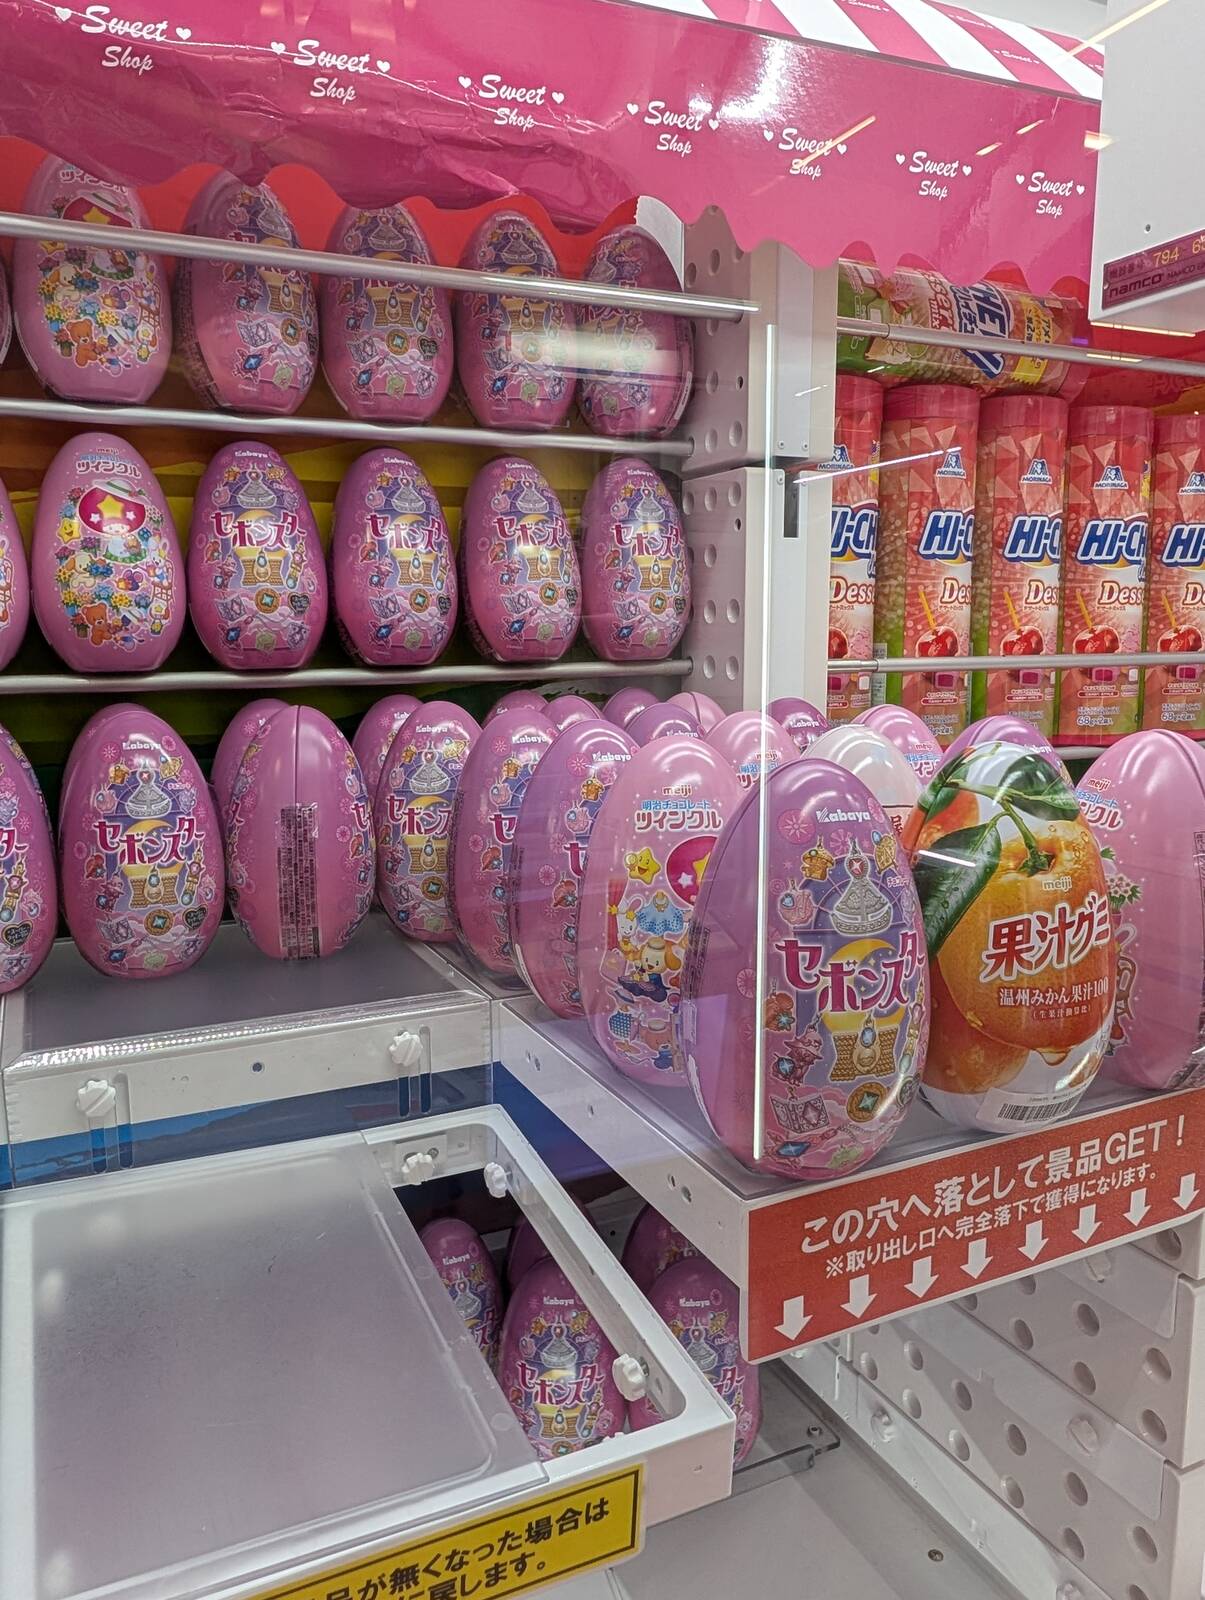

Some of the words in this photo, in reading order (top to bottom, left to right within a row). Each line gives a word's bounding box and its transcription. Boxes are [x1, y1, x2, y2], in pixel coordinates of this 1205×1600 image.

[81, 6, 168, 40] Sweet
[101, 46, 153, 75] Shop
[293, 40, 370, 73] Sweet
[310, 78, 357, 104] Shop
[479, 74, 545, 104] Sweet
[494, 107, 536, 132] Shop
[644, 100, 702, 131] Sweet
[657, 133, 692, 157] Shop
[779, 128, 833, 155] Sweet
[790, 159, 822, 180] Shop
[909, 151, 959, 177] Sweet
[919, 180, 948, 200] Shop
[1028, 172, 1073, 196] Sweet
[1036, 200, 1063, 219] Shop
[1109, 272, 1164, 298] namco
[76, 460, 142, 478] ツインクル
[209, 511, 307, 549] セボンスター
[365, 513, 448, 553] セボンスター
[493, 515, 571, 549] セボンスター
[610, 523, 685, 558] セボンスター
[592, 751, 632, 762] Kabaya
[662, 785, 692, 797] meiji
[1088, 779, 1110, 790] meiji
[641, 800, 711, 810] 明治チョコレート
[816, 807, 871, 824] Kabaya
[635, 810, 723, 832] ツインクル
[93, 816, 206, 866] セボンスター
[1043, 877, 1072, 892] meiji
[982, 892, 1110, 980] 果汁グミ
[775, 931, 925, 1012] セボンスター
[543, 1296, 575, 1306] Kabaya
[679, 1297, 711, 1308] Kabaya
[517, 1361, 604, 1405] セボンスター
